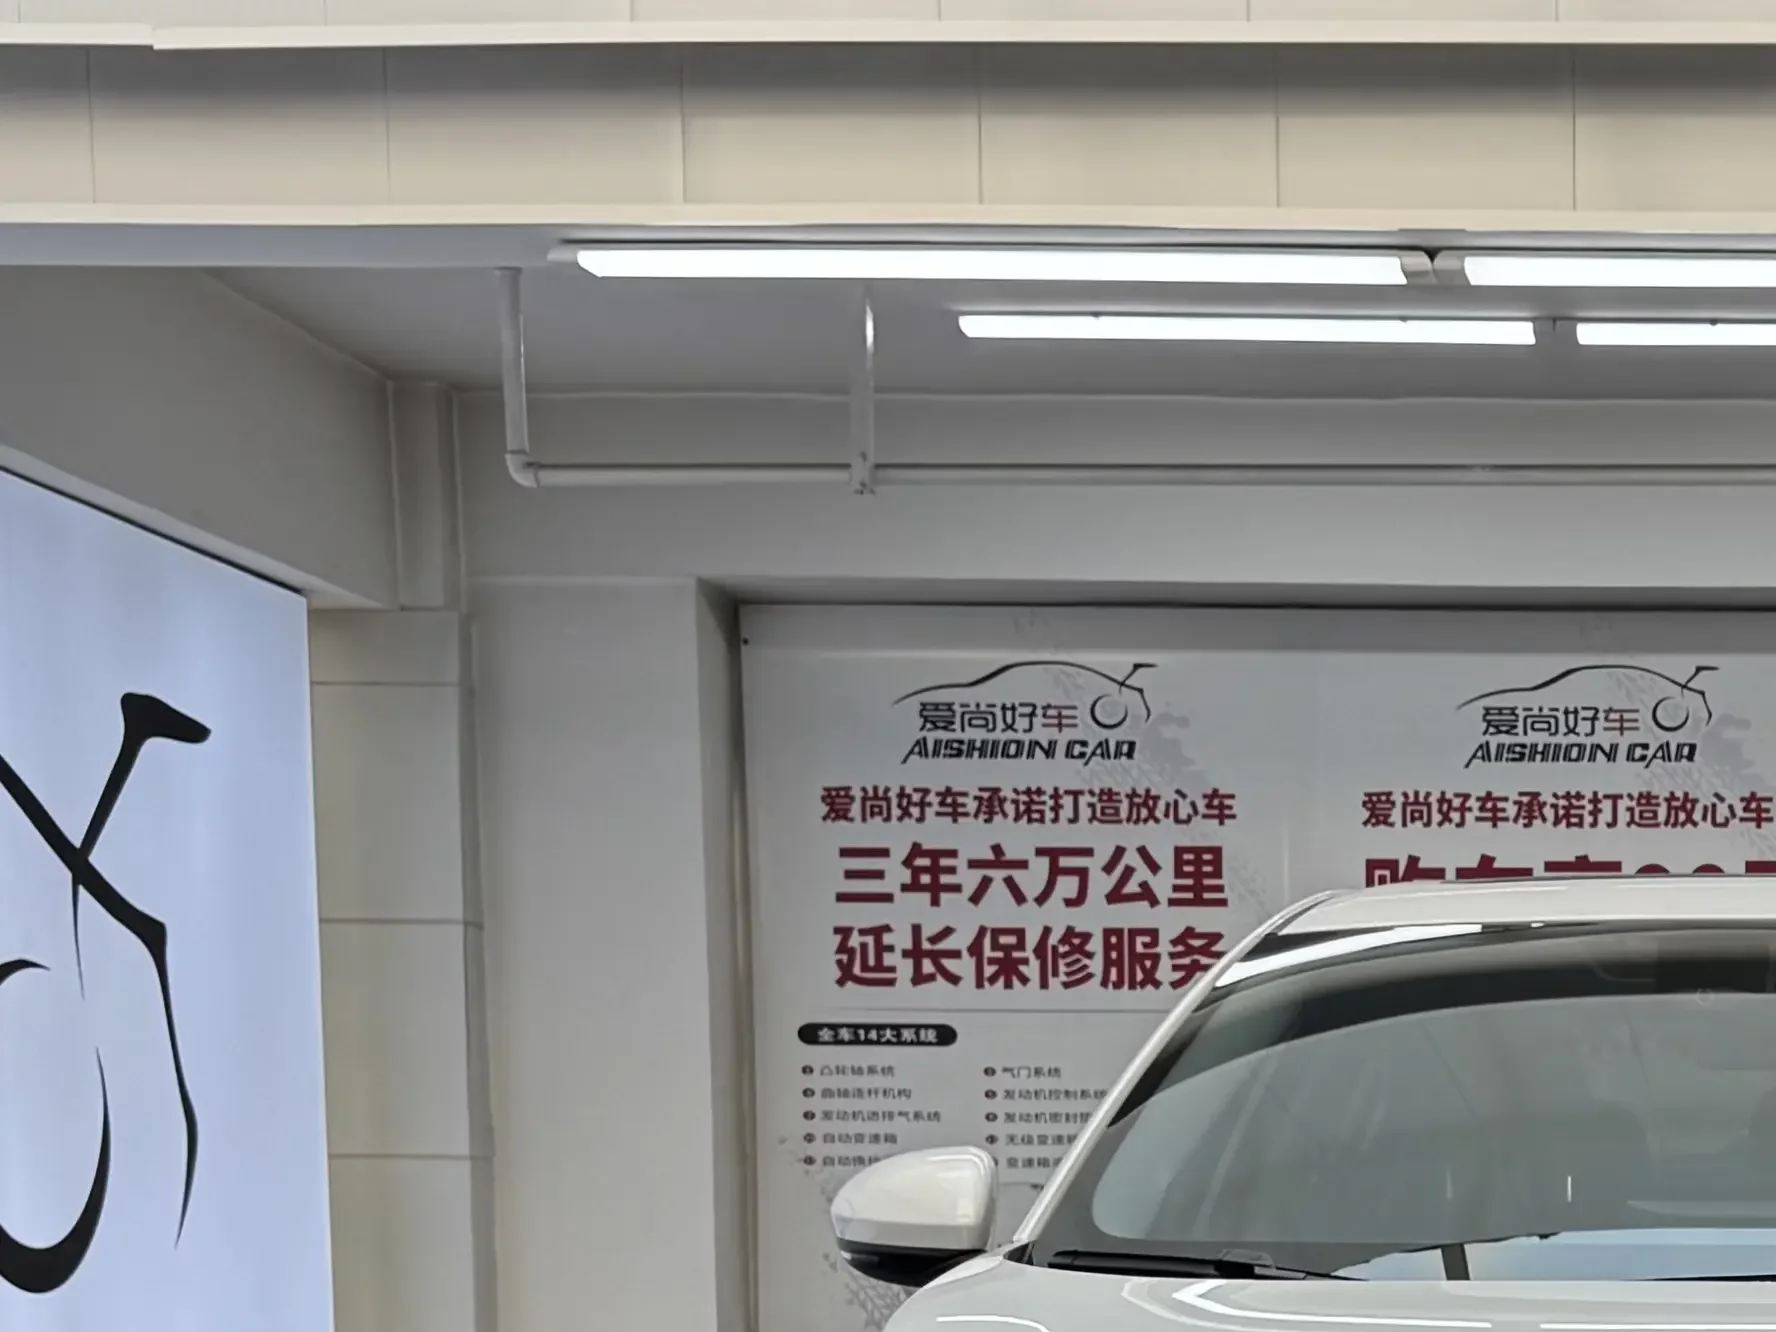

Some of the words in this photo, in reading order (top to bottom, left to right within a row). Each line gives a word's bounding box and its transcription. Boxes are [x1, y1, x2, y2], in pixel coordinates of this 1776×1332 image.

[918, 701, 1079, 734] 爱尚好车
[1481, 705, 1641, 738] 爱尚好车
[900, 737, 1058, 765] AISHION
[1064, 737, 1137, 767] CAR
[1463, 739, 1620, 769] AISHION
[1625, 739, 1698, 770] CAR
[820, 784, 1238, 827] 爱尚好车承诺打造放心车
[1361, 789, 1775, 830] 爱尚好车承诺打造放心车
[834, 840, 1229, 910] 三年六万公里
[832, 922, 1227, 991] 延长保修服务
[817, 1027, 939, 1043] 全车14大系统
[1001, 1066, 1062, 1079] 气门系统
